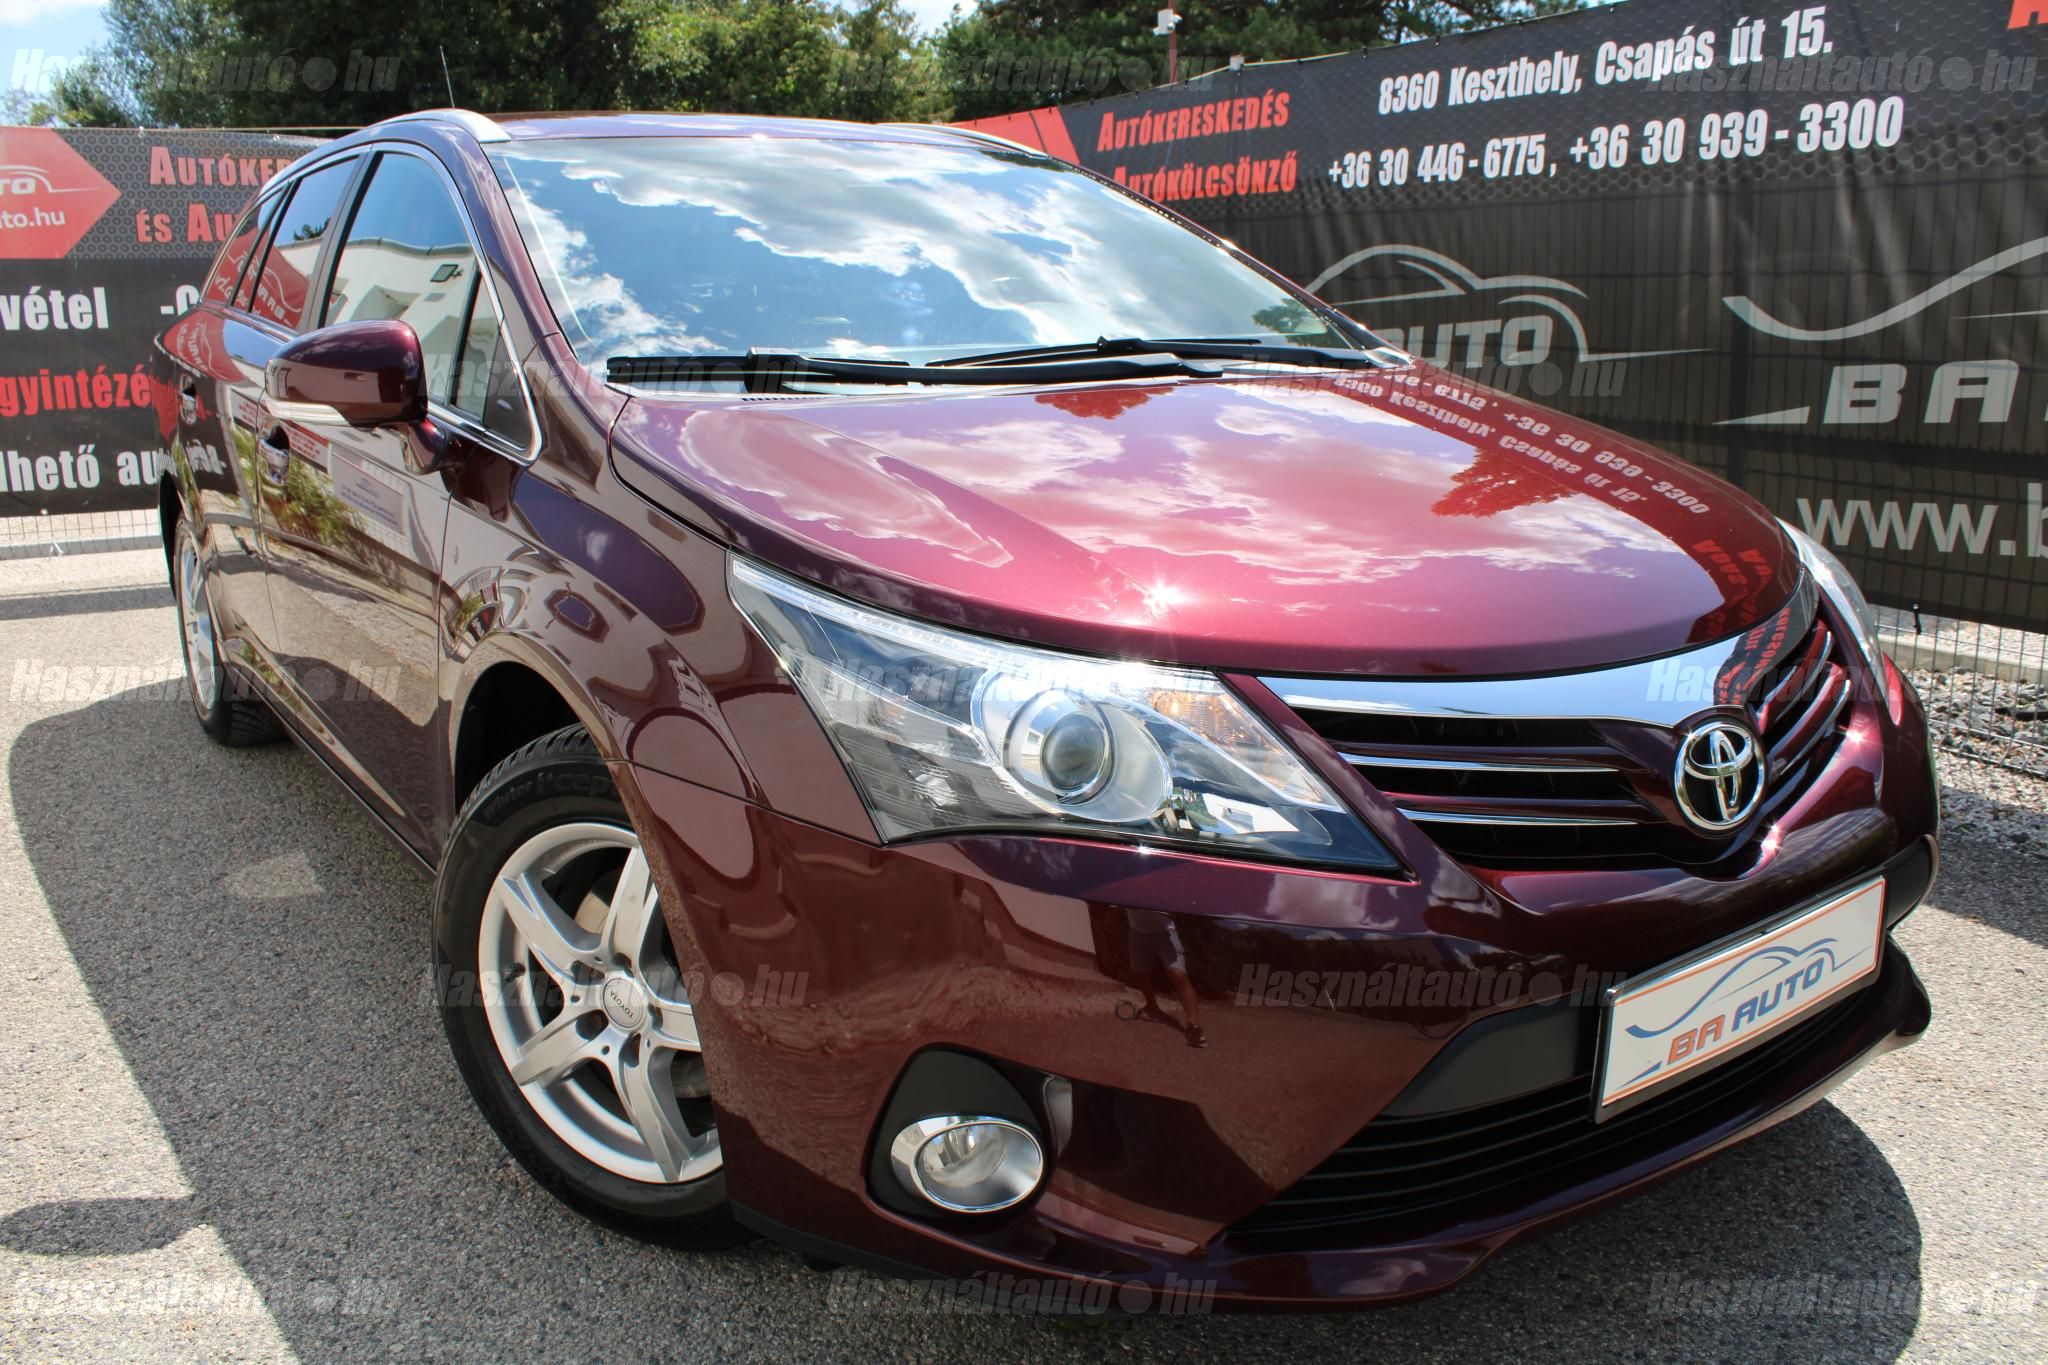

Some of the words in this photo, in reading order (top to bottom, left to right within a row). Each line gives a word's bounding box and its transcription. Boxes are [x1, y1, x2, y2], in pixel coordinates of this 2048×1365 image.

[1378, 71, 1440, 115] 8360
[1448, 51, 1583, 106] Keszthely,
[1595, 25, 1716, 85] Csapás
[1729, 16, 1766, 66] út
[1781, 6, 1833, 58] 15.
[150, 146, 293, 187] AUTÓKE
[1328, 151, 1372, 189] +36
[1378, 148, 1409, 186] 30
[1569, 124, 1630, 170] +36
[1641, 117, 1685, 165] 30
[0, 207, 65, 230] to.hu
[136, 208, 172, 243] ÉS
[1667, 1014, 1725, 1066] BA
[1731, 957, 1825, 1032] AUTO
